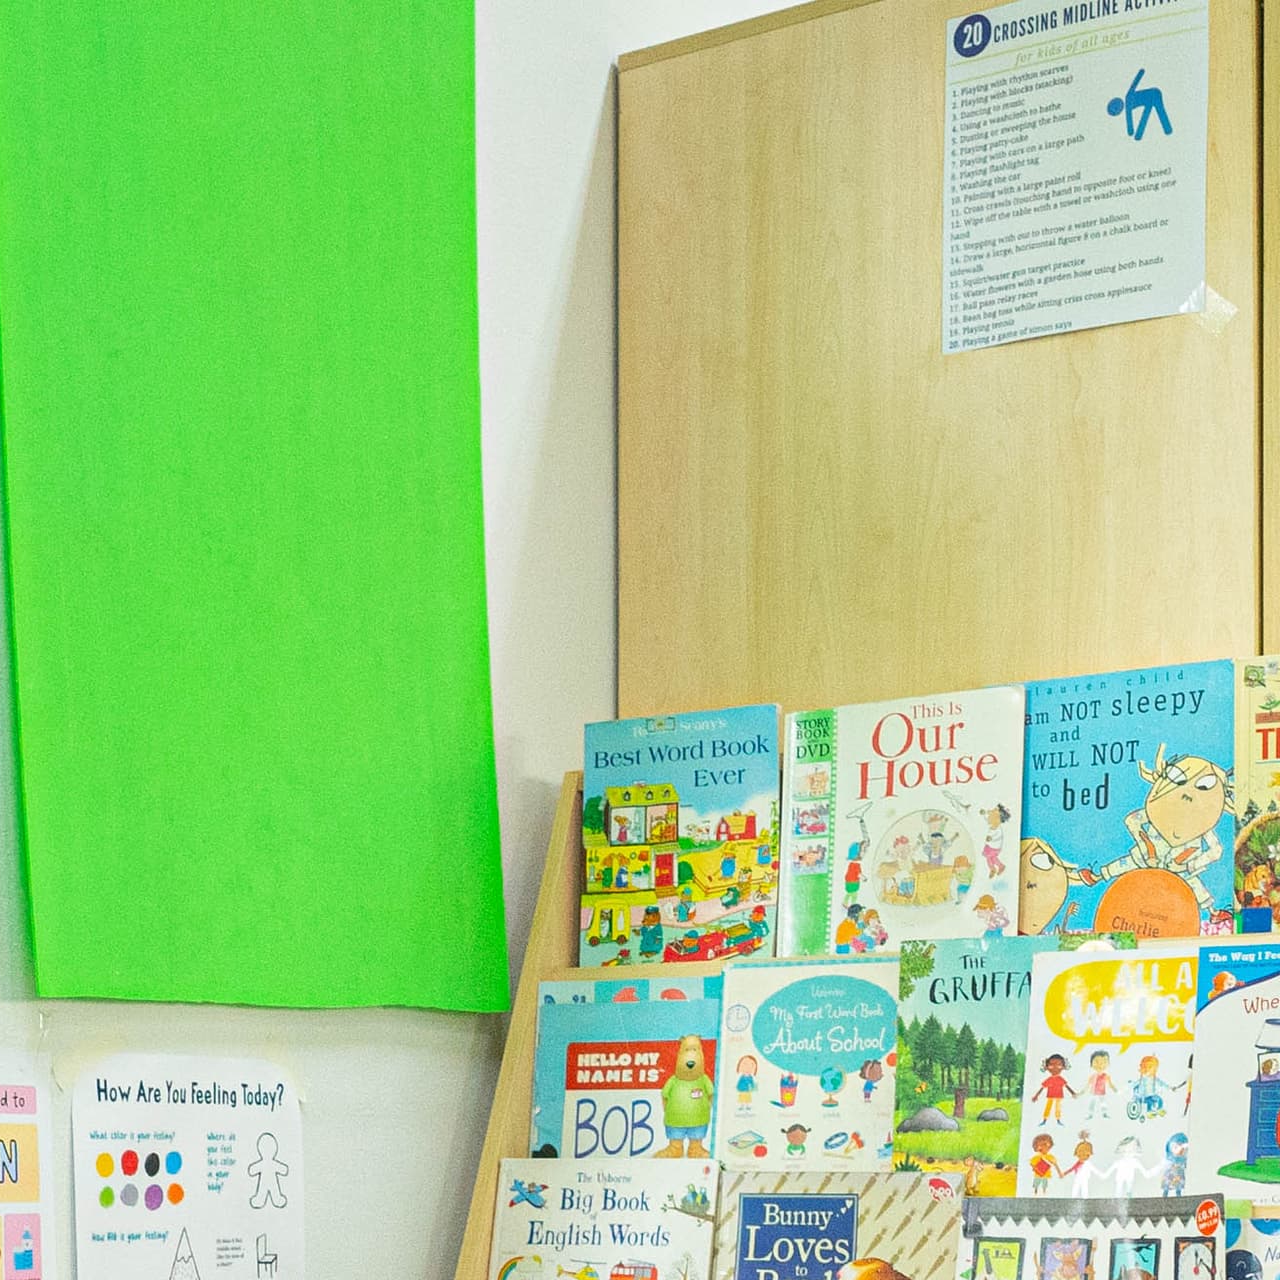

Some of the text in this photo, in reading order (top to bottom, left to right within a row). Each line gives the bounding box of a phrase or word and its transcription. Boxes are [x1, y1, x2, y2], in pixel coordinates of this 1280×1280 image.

[962, 22, 984, 49] 20
[993, 11, 1058, 43] CROSSING
[1063, 0, 1119, 26] MIDLINE
[1037, 43, 1062, 60] kids
[1081, 33, 1098, 48] all
[1102, 29, 1131, 46] ages
[961, 82, 989, 97] Playing
[1035, 669, 1186, 696] lauren child
[910, 701, 963, 719] This Is
[1024, 688, 1206, 726] am NOT sleepy
[795, 716, 831, 730] STORY
[796, 728, 830, 740] BOOK
[871, 711, 965, 759] Our
[1049, 726, 1080, 744] and
[594, 734, 771, 769] Best Word Book
[795, 743, 831, 760] DVD
[1032, 740, 1141, 771] WILL NOT
[693, 767, 747, 788] Ever
[855, 753, 1000, 801] House
[1032, 773, 1110, 811] to bed
[1111, 915, 1160, 938] Charlie
[959, 954, 987, 970] THE
[1208, 953, 1228, 964] The
[1231, 952, 1256, 964] Way
[770, 999, 885, 1032] My First Word Book
[763, 1025, 886, 1055] About School
[576, 1050, 661, 1069] HELLO MY
[576, 1067, 660, 1084] NAME IS
[14, 1092, 26, 1108] to
[96, 1078, 285, 1112] How Are You Feeling Today?
[575, 1098, 655, 1158] BOB
[560, 1187, 651, 1215] Big Book
[763, 1202, 833, 1230] Bunny
[526, 1220, 671, 1252] English Words
[744, 1223, 852, 1265] Loves
[795, 1263, 809, 1277] to
